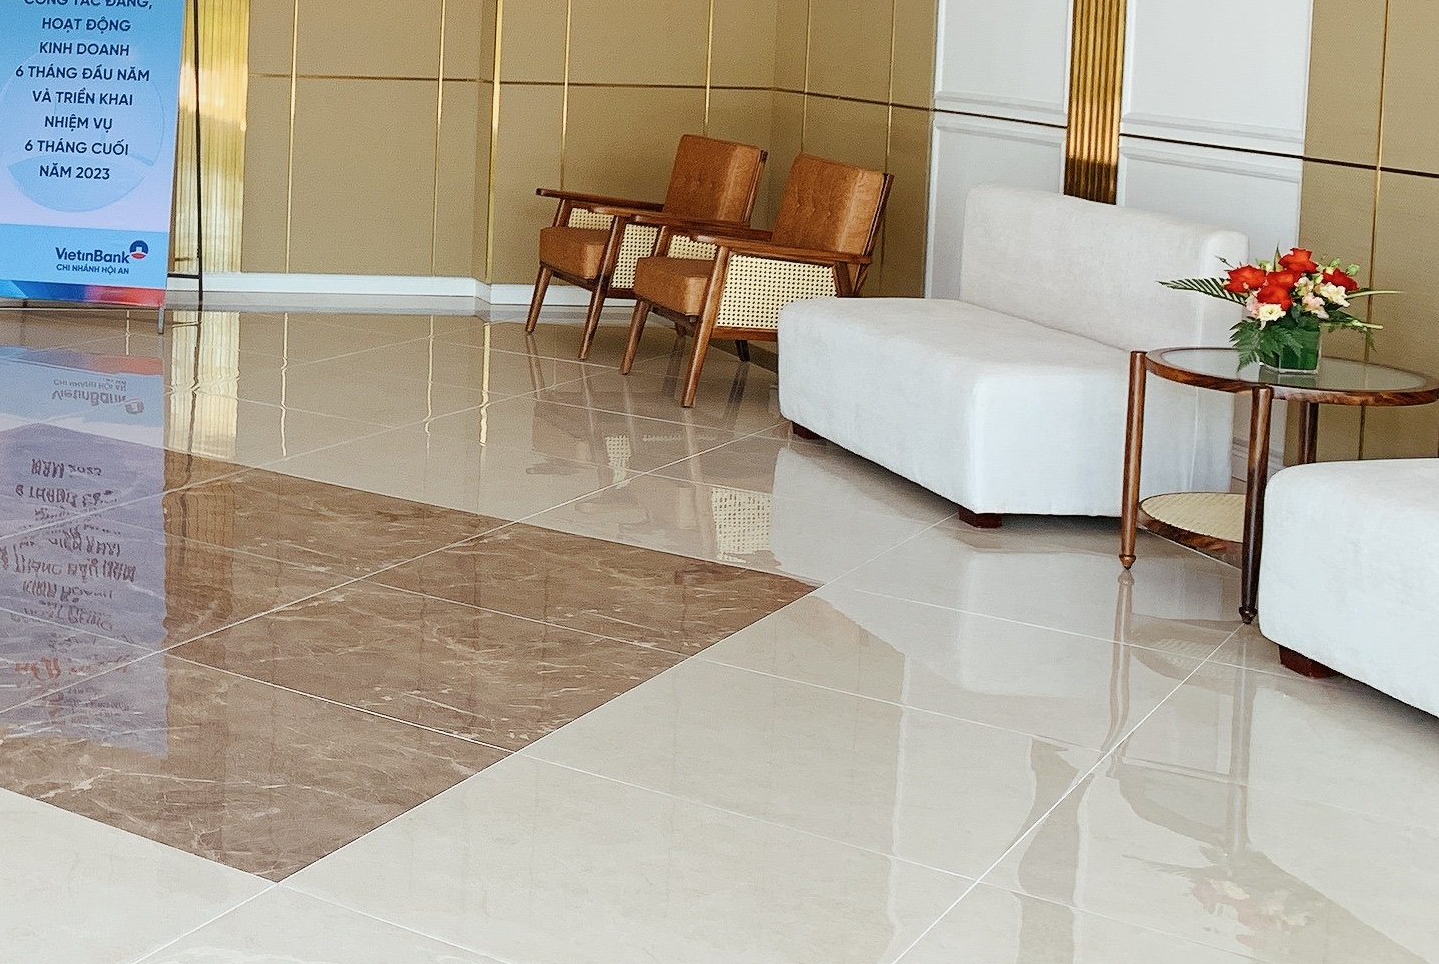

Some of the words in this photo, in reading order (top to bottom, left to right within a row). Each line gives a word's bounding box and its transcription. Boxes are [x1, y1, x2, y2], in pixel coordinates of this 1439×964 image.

[42, 17, 82, 33] HOẠT
[86, 16, 131, 34] ĐỘNG
[39, 41, 72, 55] KINH
[76, 42, 130, 56] DOANH
[15, 65, 24, 77] 6
[28, 63, 78, 79] THÁNG
[117, 66, 150, 81] NĂM
[32, 88, 52, 103] VÀ
[56, 87, 95, 104] TRIỂN
[99, 92, 133, 106] KHAI
[44, 114, 89, 132] NHIỆM
[93, 117, 113, 133] VỤ
[25, 139, 33, 152] 6
[37, 138, 87, 154] THÁNG
[91, 139, 128, 156] CUỐI
[39, 164, 72, 179] NĂM
[76, 167, 110, 180] 2023
[55, 247, 130, 264] VietinBank
[56, 263, 71, 272] CHI
[72, 263, 100, 274] NHÁNH
[101, 264, 117, 276] HỘI
[118, 266, 130, 275] AN
